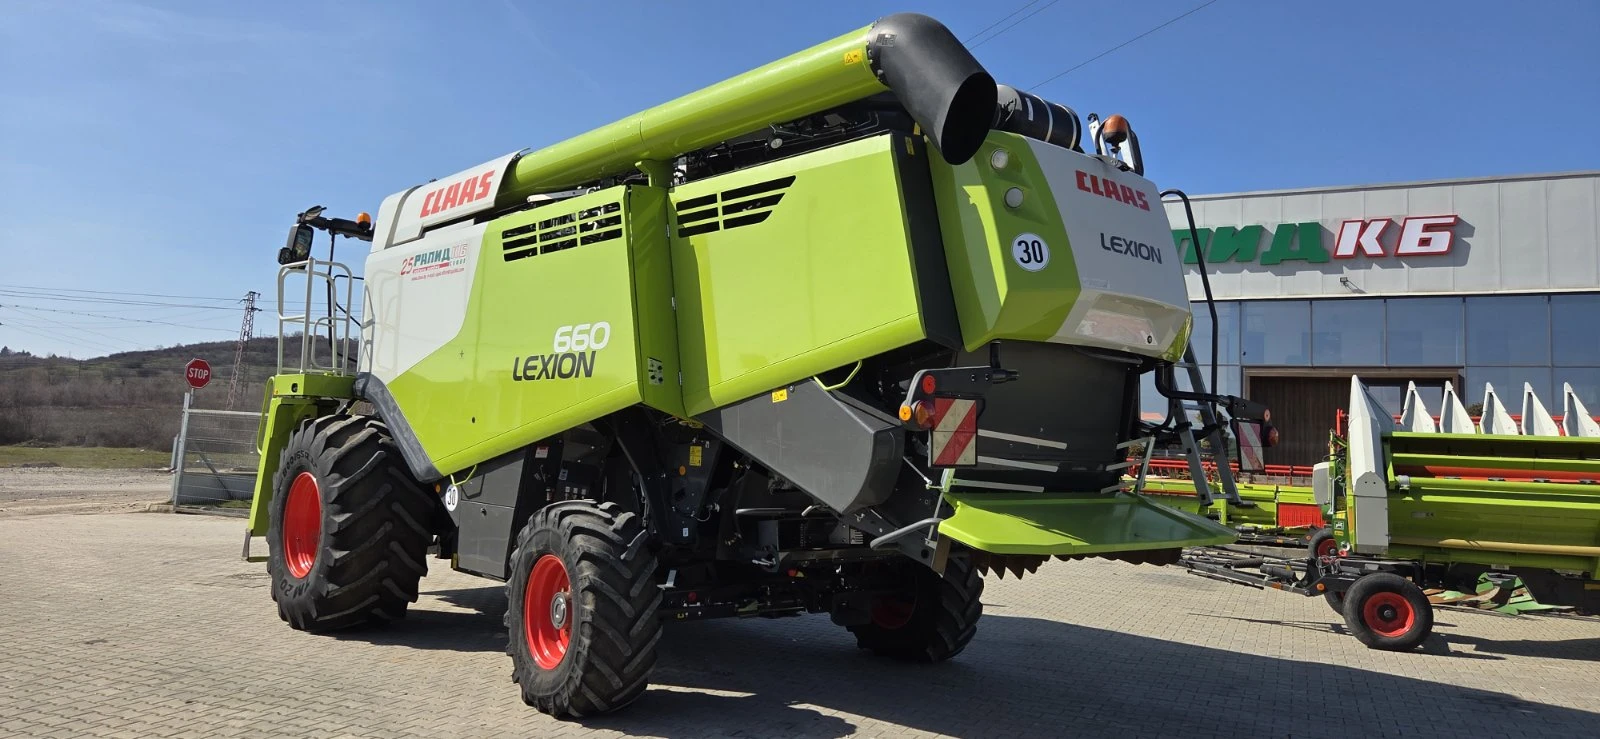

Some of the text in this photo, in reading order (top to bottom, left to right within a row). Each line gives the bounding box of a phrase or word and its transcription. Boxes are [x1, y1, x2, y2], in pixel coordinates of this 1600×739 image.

[420, 170, 495, 217] CLAAS
[1075, 169, 1151, 212] CLAAS
[1018, 239, 1045, 265] 30
[1099, 232, 1163, 265] LEXION
[1172, 222, 1329, 265] ПИД
[400, 257, 414, 276] 25
[553, 321, 610, 353] 660
[188, 366, 209, 379] STOP
[512, 350, 597, 381] LEXION
[447, 488, 456, 506] 30
